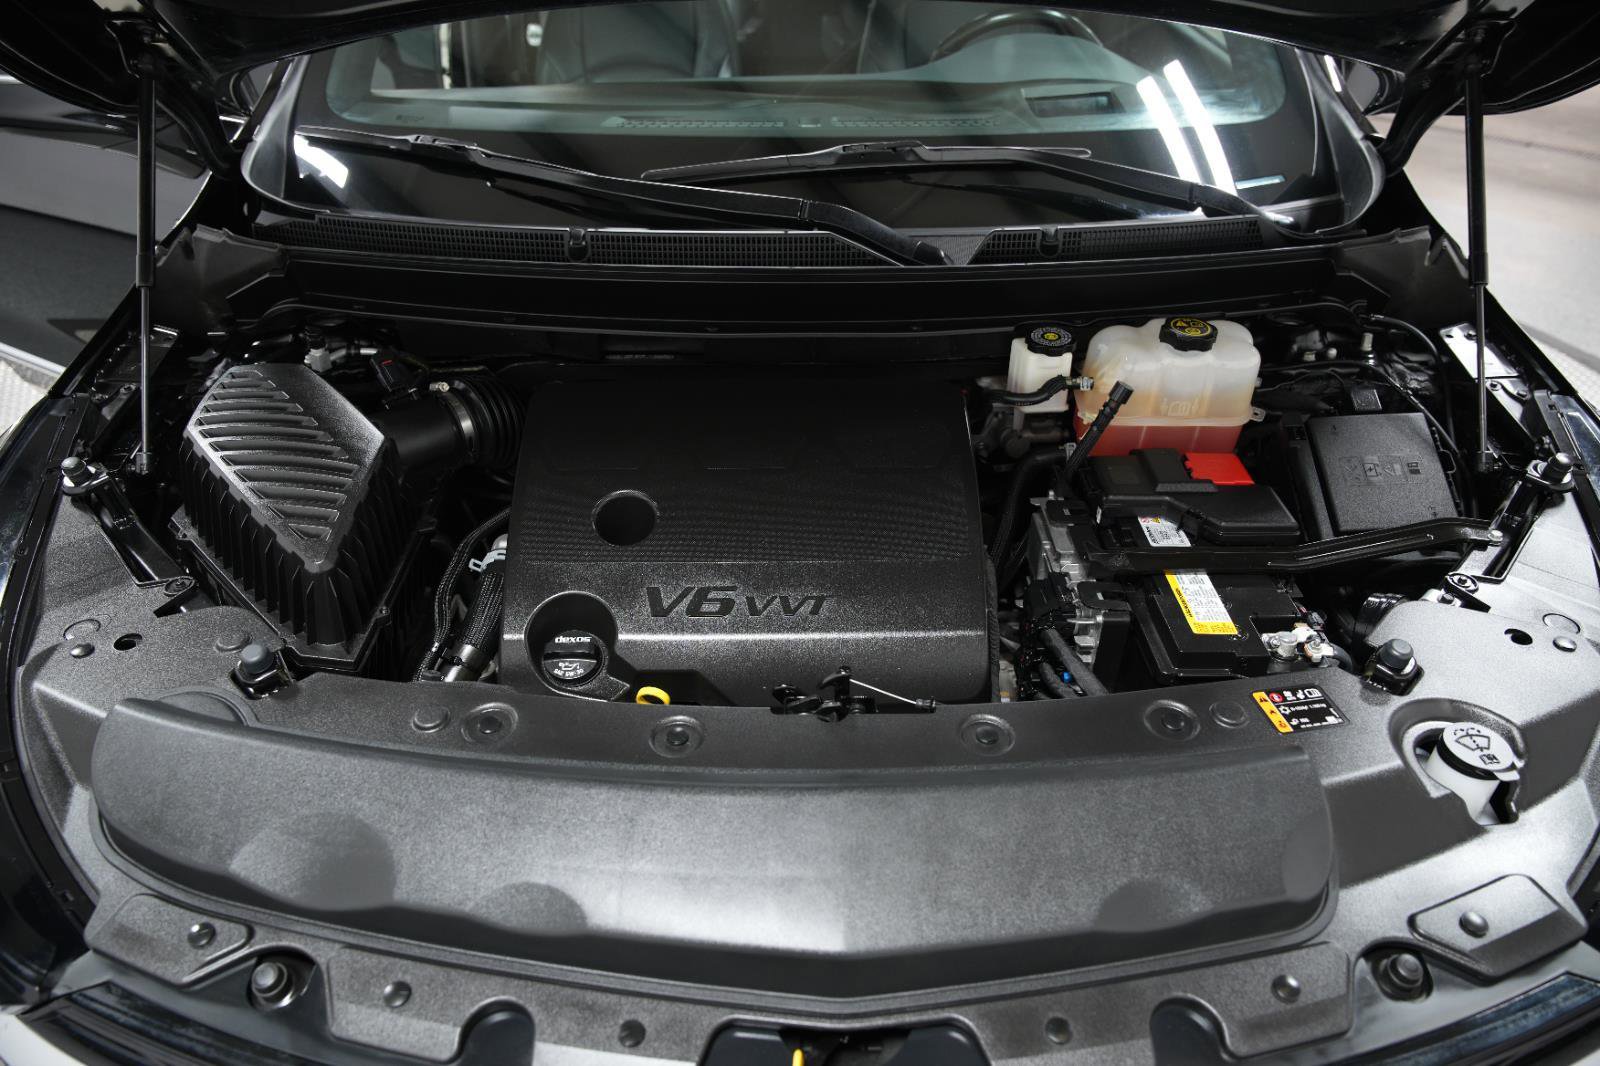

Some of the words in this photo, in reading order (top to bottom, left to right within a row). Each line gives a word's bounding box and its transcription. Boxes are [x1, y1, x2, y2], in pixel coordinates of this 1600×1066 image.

[646, 585, 739, 618] V6
[746, 594, 834, 617] VVT
[554, 635, 592, 644] dexos
